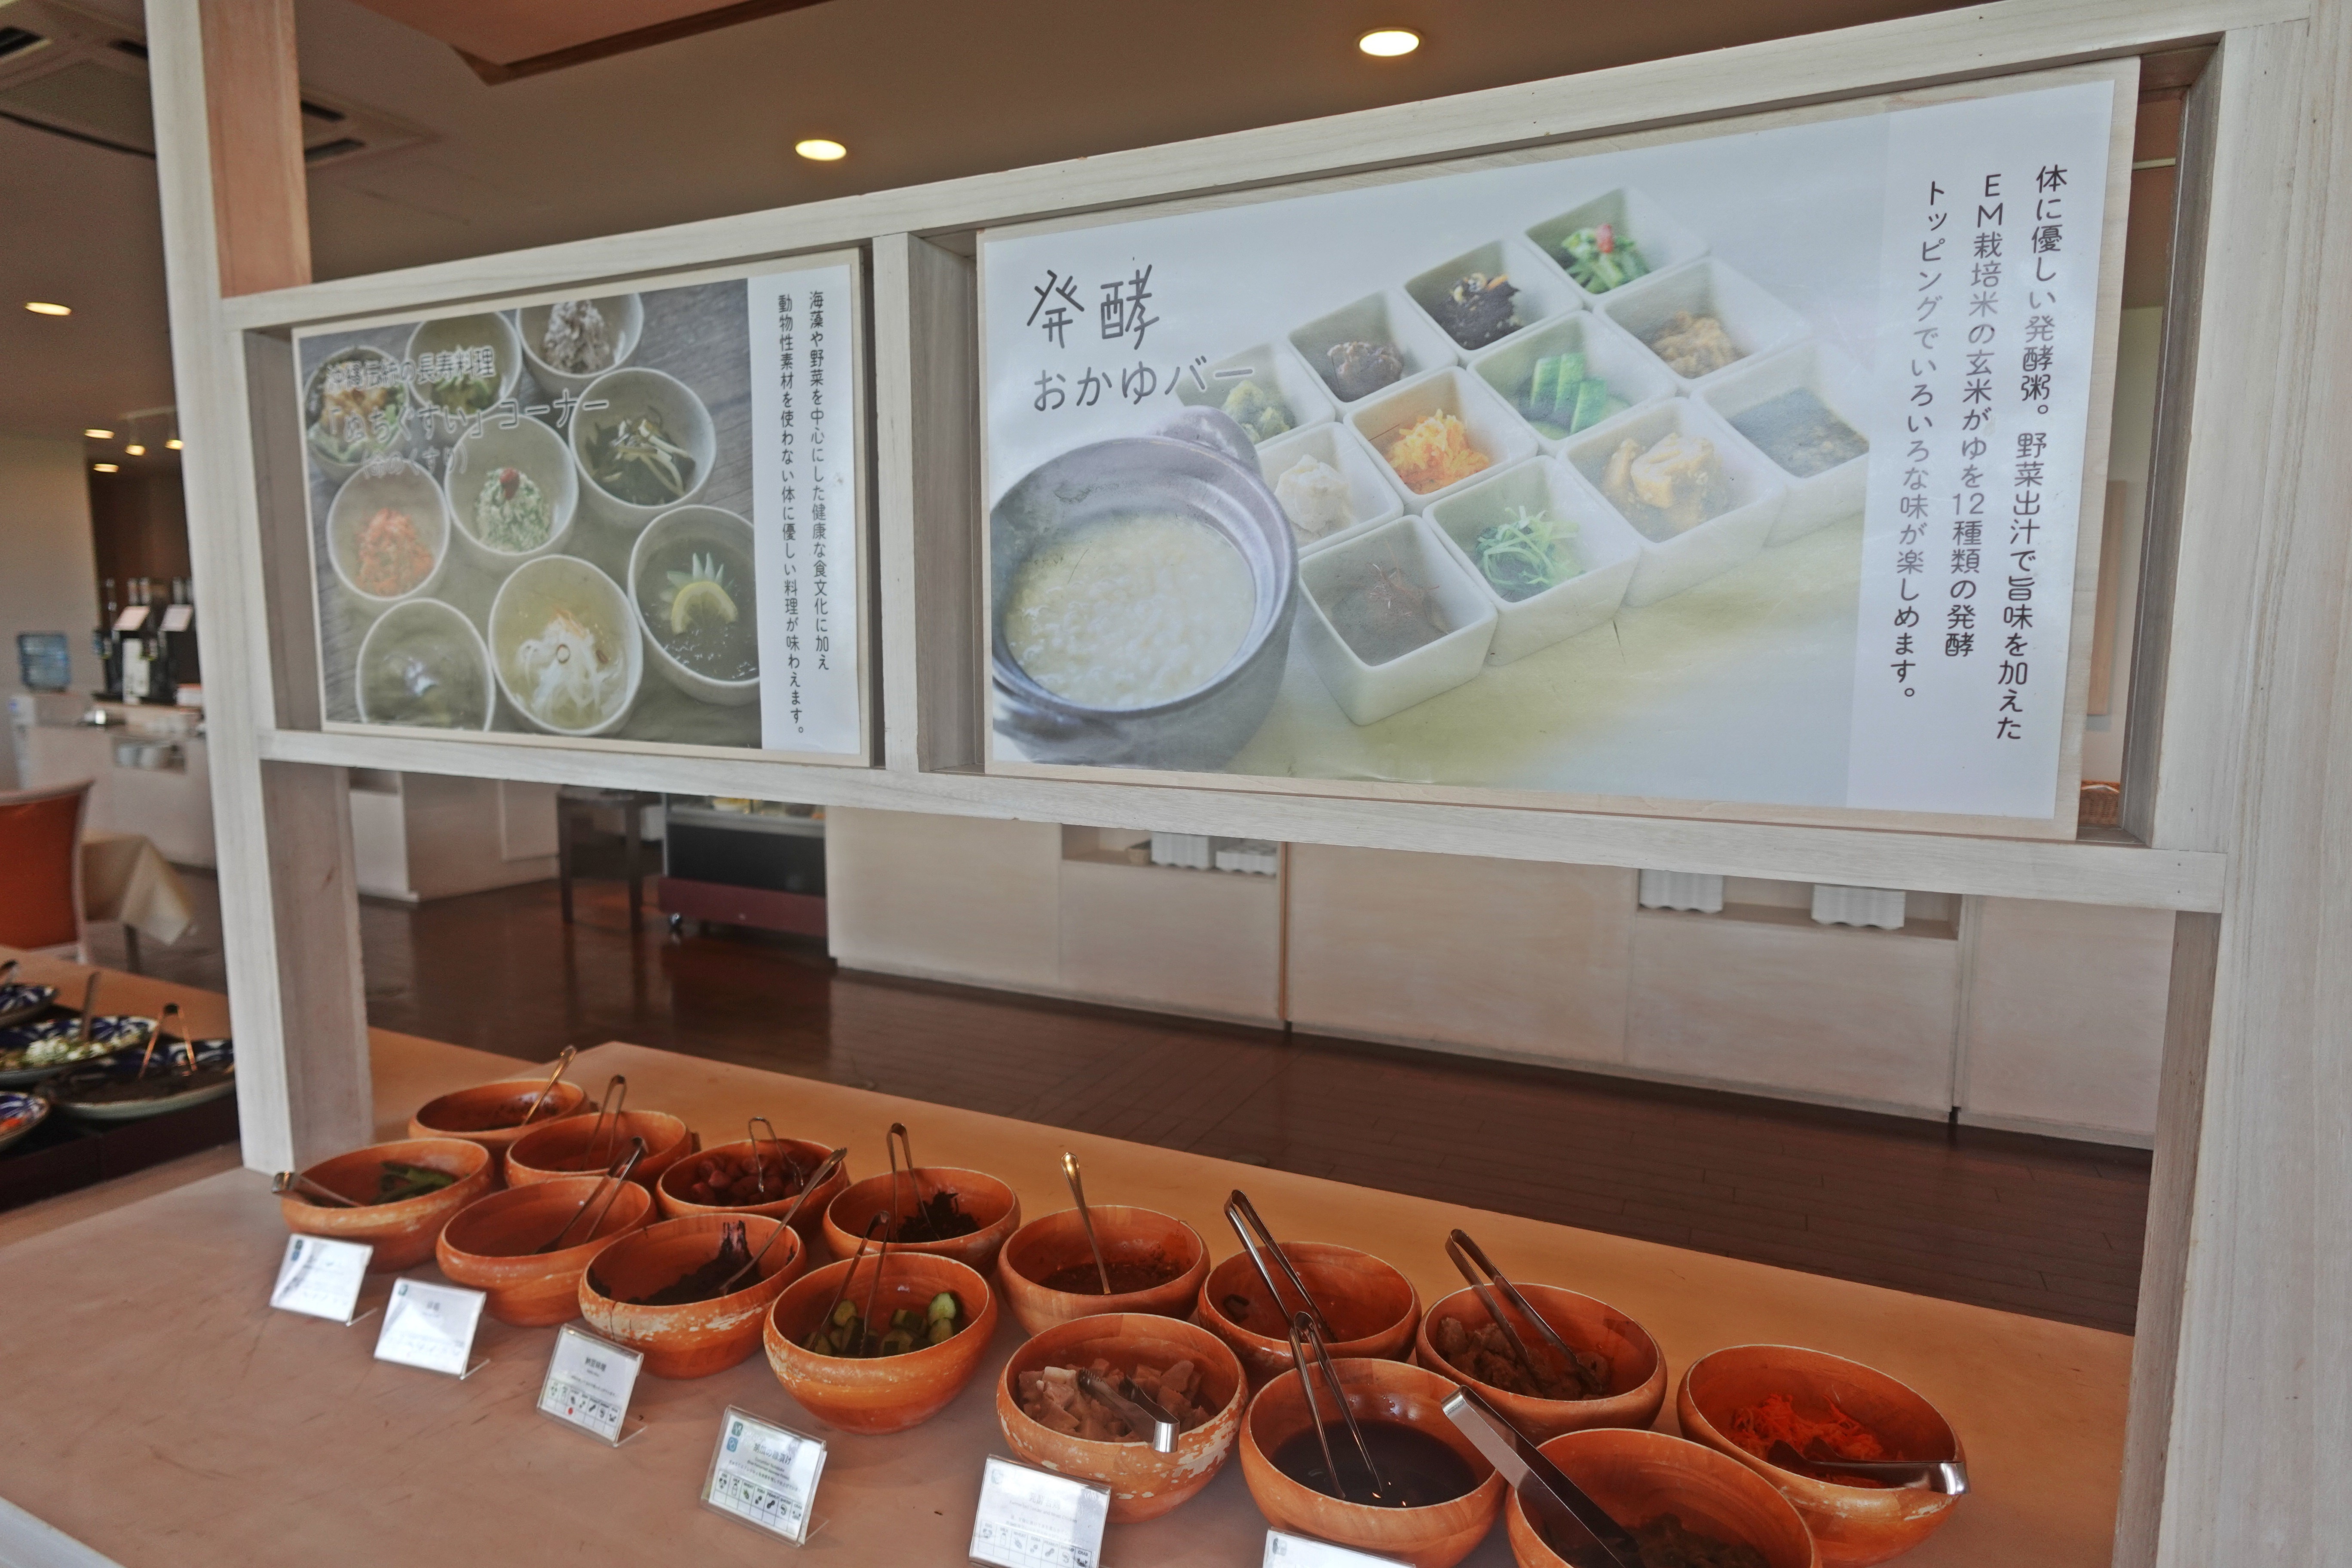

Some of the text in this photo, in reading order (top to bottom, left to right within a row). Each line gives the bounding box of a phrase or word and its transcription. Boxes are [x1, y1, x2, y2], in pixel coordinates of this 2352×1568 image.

[778, 294, 803, 733] 動物性素材を使わない体に優しい料理が味わえます。
[809, 291, 829, 670] 海藻や野菜を中心にした健康な食文化に加え
[1027, 264, 1160, 350] 発酵
[1034, 355, 1253, 411] おかゆバー
[1890, 181, 1947, 697] トッピングでいろいろな味が楽しめます。
[1945, 174, 2003, 657] EM栽培米の玄米がゆを12種類の発酵
[1997, 164, 2067, 740] 体に優しい発酵粥。野菜出汁で旨味を加えた
